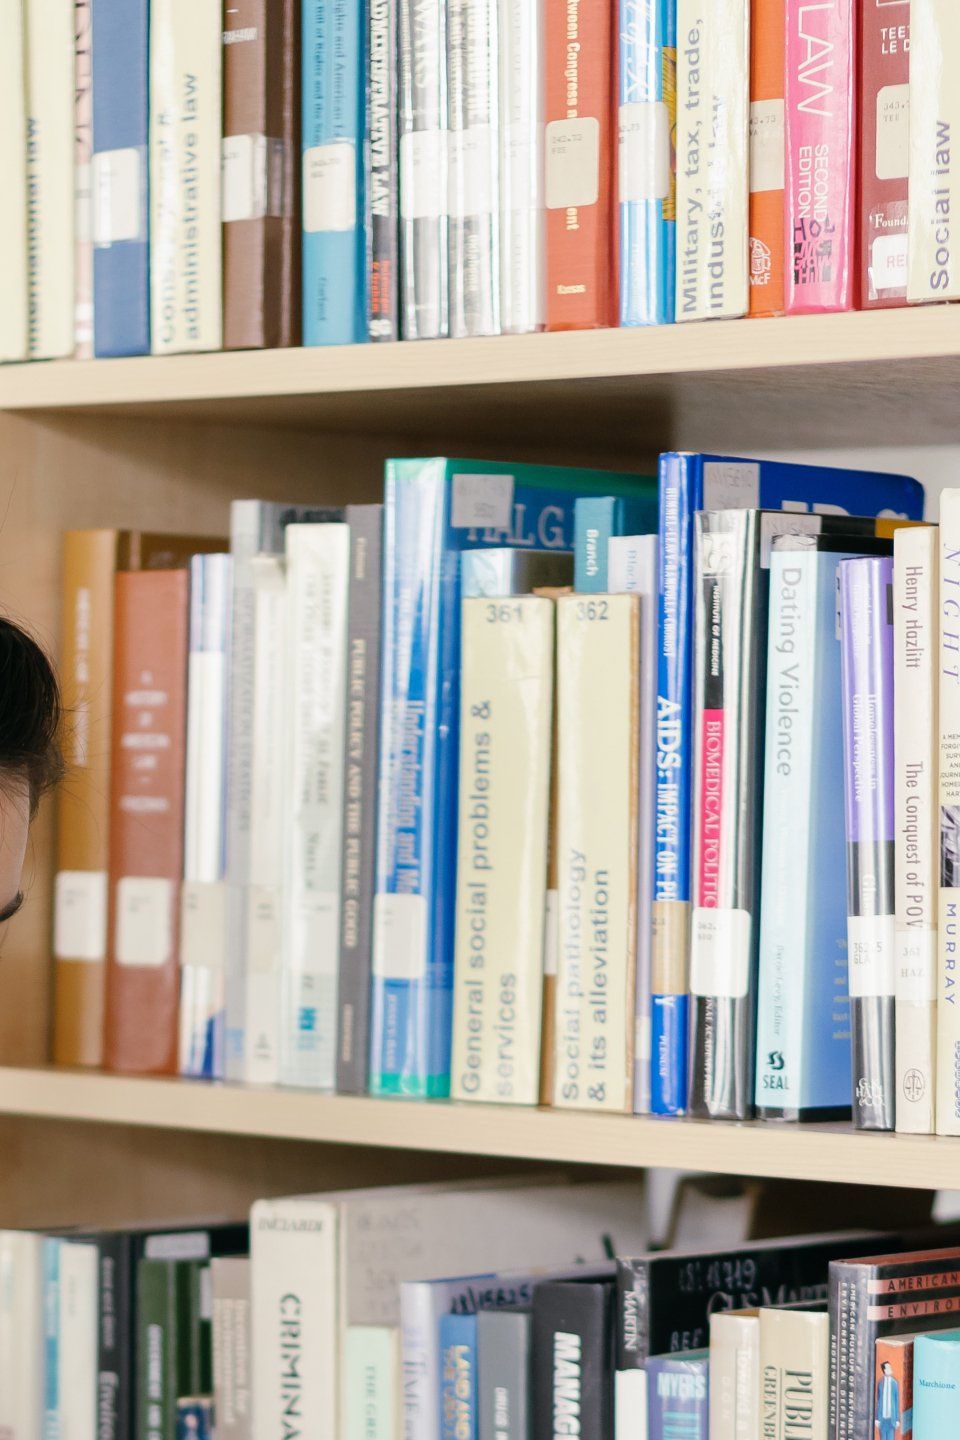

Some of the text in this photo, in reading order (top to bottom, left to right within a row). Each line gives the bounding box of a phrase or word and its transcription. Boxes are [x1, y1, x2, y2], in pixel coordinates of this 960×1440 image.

[565, 42, 580, 106] Congress
[797, 3, 834, 117] LAW
[180, 73, 201, 340] administrative law
[371, 172, 389, 216] LAW
[682, 19, 703, 313] Military, tax, trade,
[798, 144, 829, 222] SECOND EDITION
[930, 121, 950, 290] Social law
[585, 529, 599, 577] Branch
[486, 604, 524, 623] 361
[577, 601, 608, 620] 362
[711, 585, 721, 676] INSTITUTE OF MEDICINE
[902, 565, 924, 669] Henry Hazlitt
[775, 567, 802, 776] Dating Violence
[396, 698, 426, 829] Understanding
[656, 695, 681, 777] AIDS:
[852, 735, 863, 802] Perspective
[343, 639, 366, 949] PUBLIC POLICY AND THE PUBLIC GOOD
[656, 783, 678, 844] IMPACT
[703, 721, 721, 908] BIOMEDICAL POLITIC
[902, 761, 923, 887] The Conquest of
[460, 699, 493, 1094] General social problems &
[656, 851, 676, 874] ON
[562, 848, 587, 1101] Social pathology
[588, 868, 609, 1103] & its alleviation
[944, 903, 956, 1005] MURRAY
[492, 972, 516, 1097] services
[773, 1005, 783, 1036] Editor
[763, 1075, 789, 1090] SEAL
[623, 1290, 638, 1351] MARTIN
[888, 1273, 958, 1291] AMERICAN
[657, 1372, 706, 1398] MYERS
[847, 1375, 854, 1387] OF
[920, 1378, 956, 1389] Marchione
